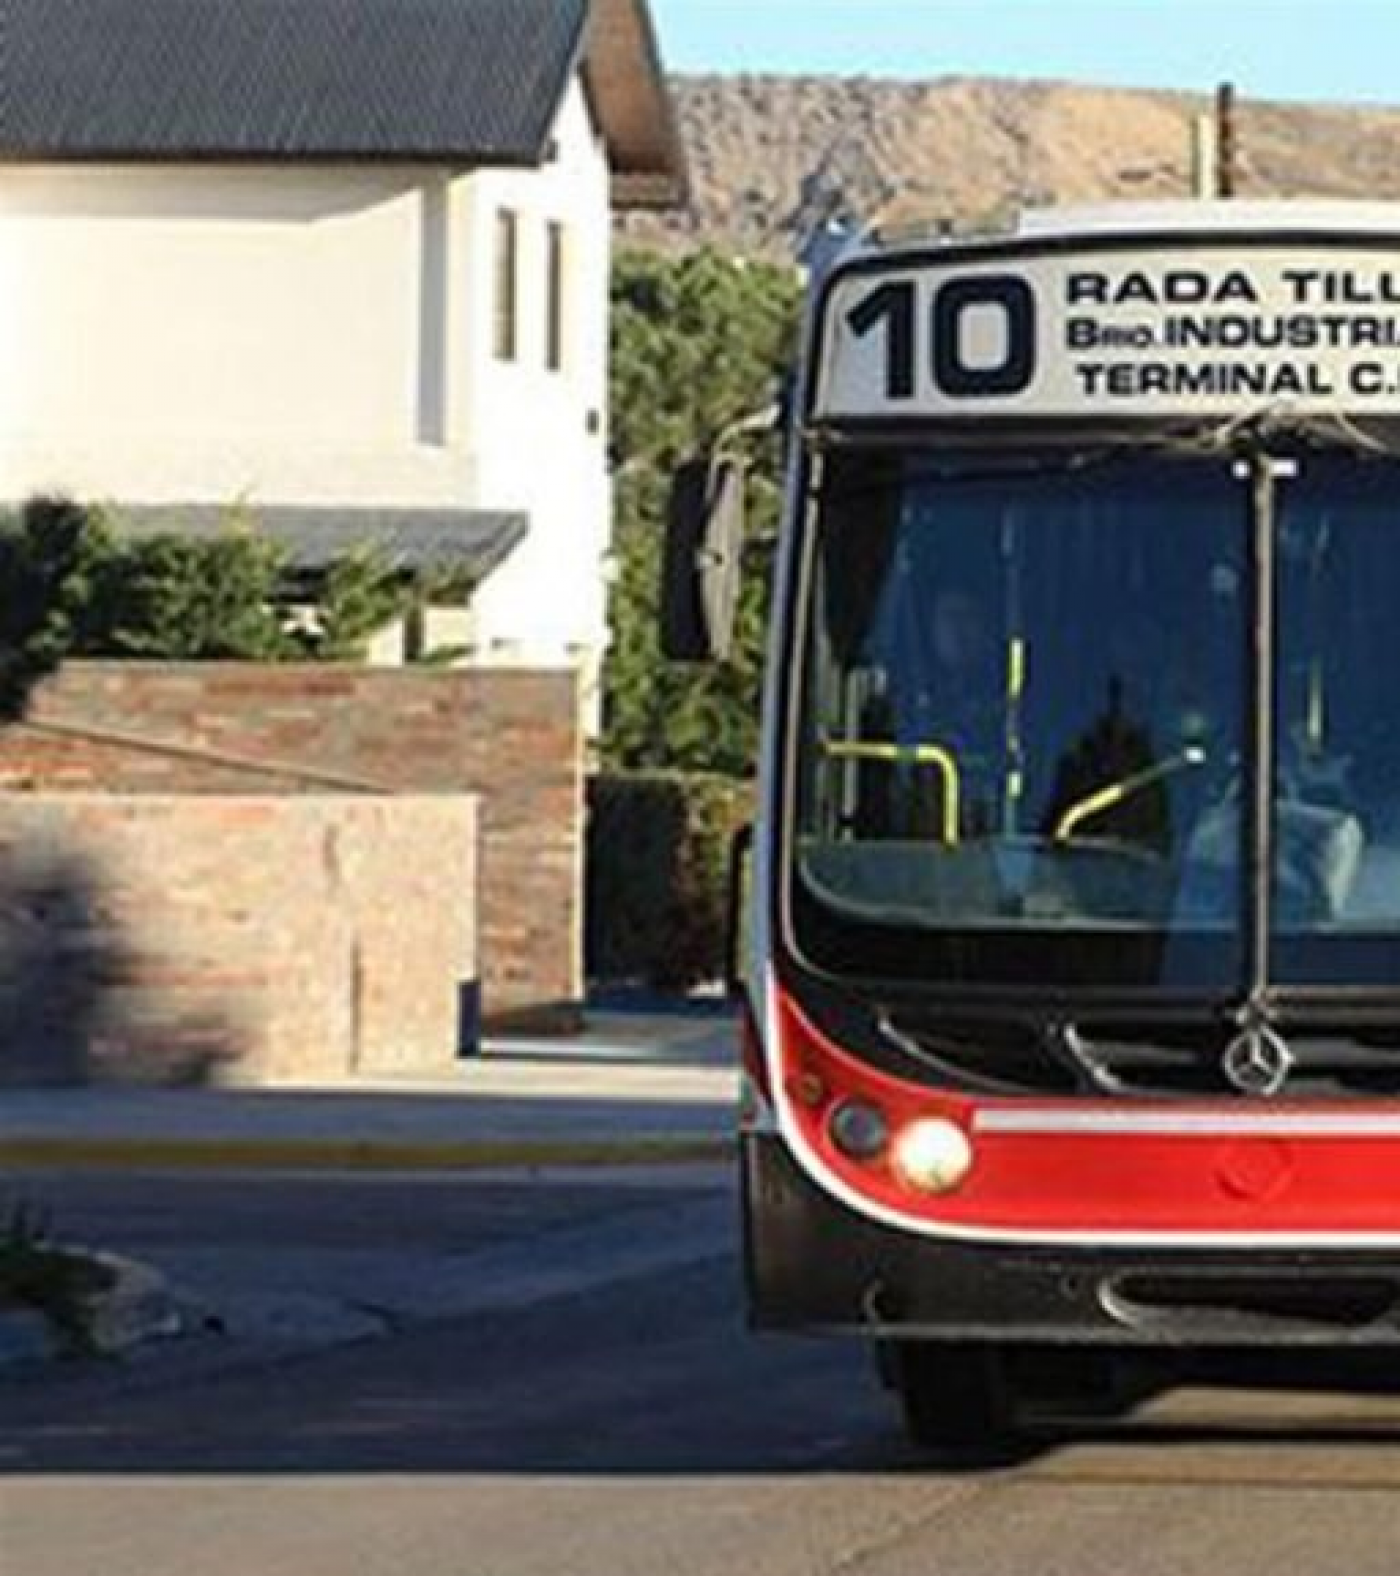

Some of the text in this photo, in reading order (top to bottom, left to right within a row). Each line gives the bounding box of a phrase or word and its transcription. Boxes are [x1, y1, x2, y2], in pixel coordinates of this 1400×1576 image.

[1066, 269, 1260, 305] RADA
[844, 274, 1037, 400] 10
[1074, 362, 1334, 396] TERMINAL
